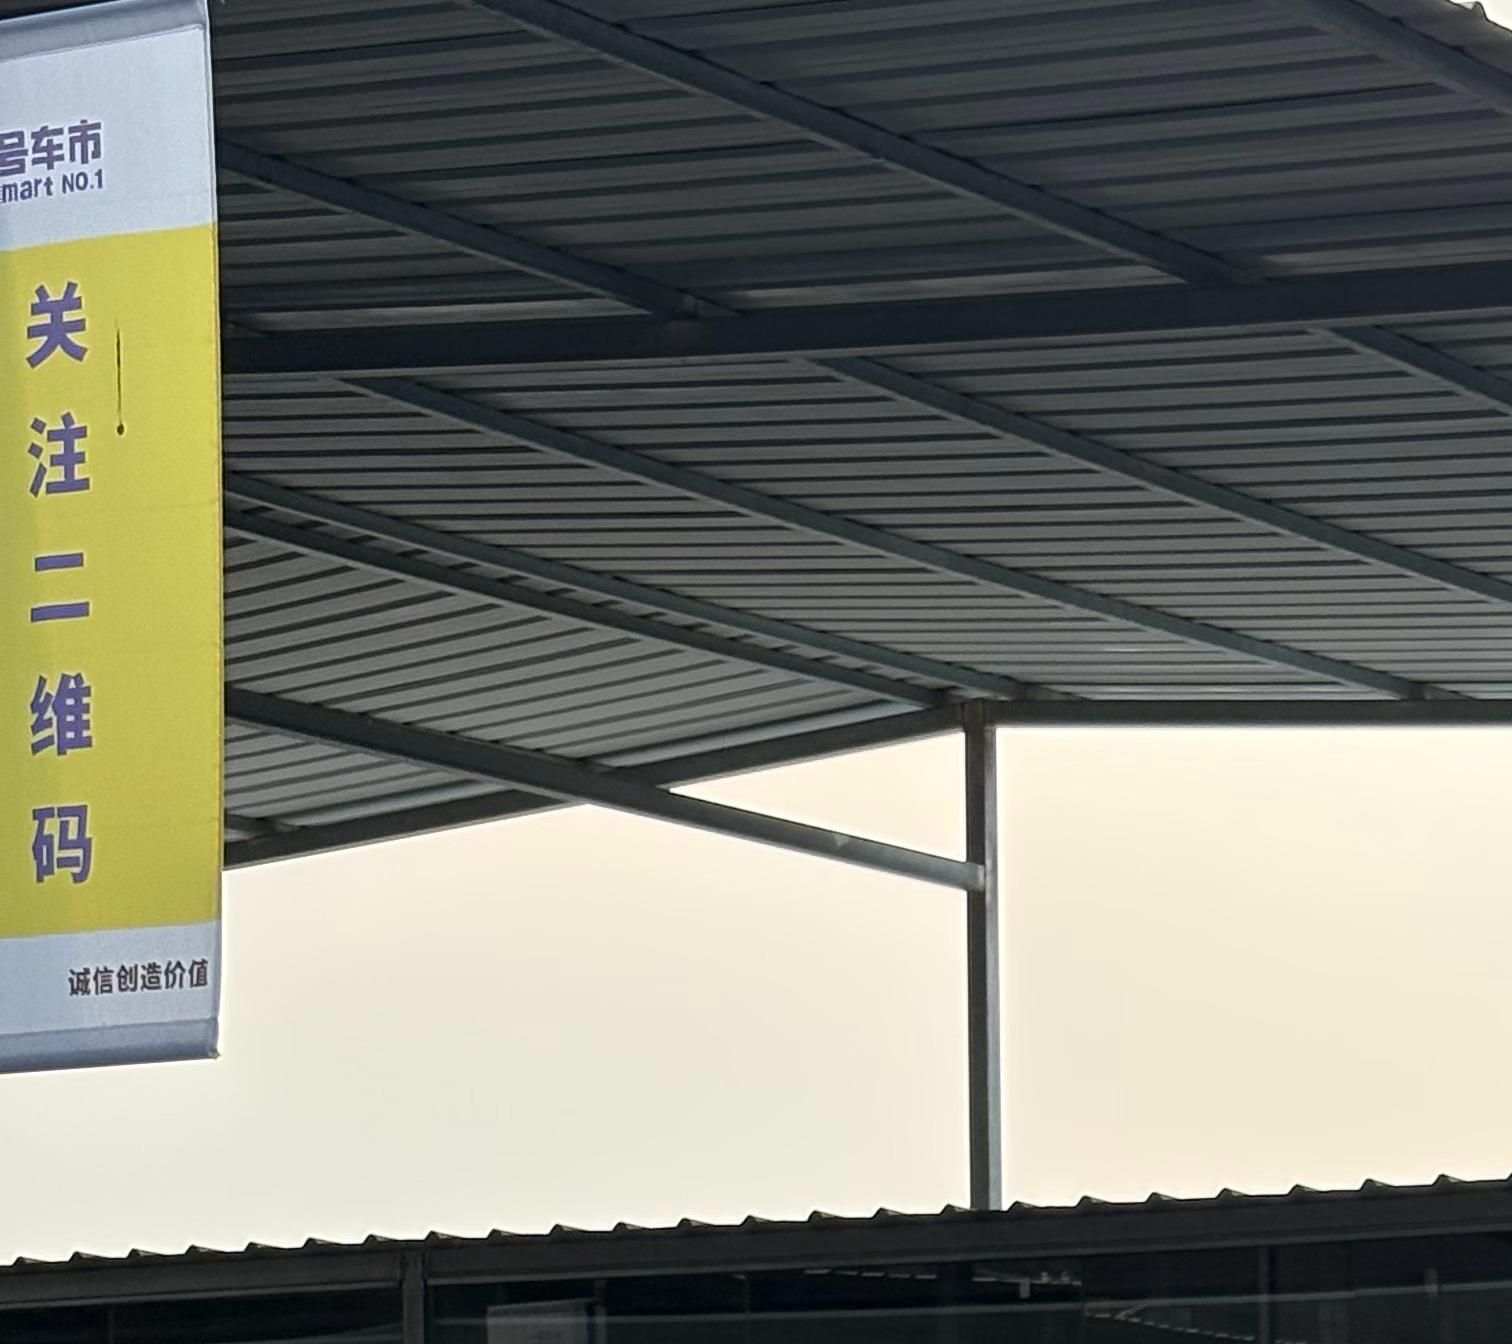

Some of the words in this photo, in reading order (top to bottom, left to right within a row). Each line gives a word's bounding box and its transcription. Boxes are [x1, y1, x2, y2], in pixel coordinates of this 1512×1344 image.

[0, 119, 102, 177] 号车市
[0, 176, 54, 203] mart
[62, 168, 103, 194] NO.1
[26, 281, 93, 885] 关注二维码
[68, 958, 209, 996] 诚信创造价值
